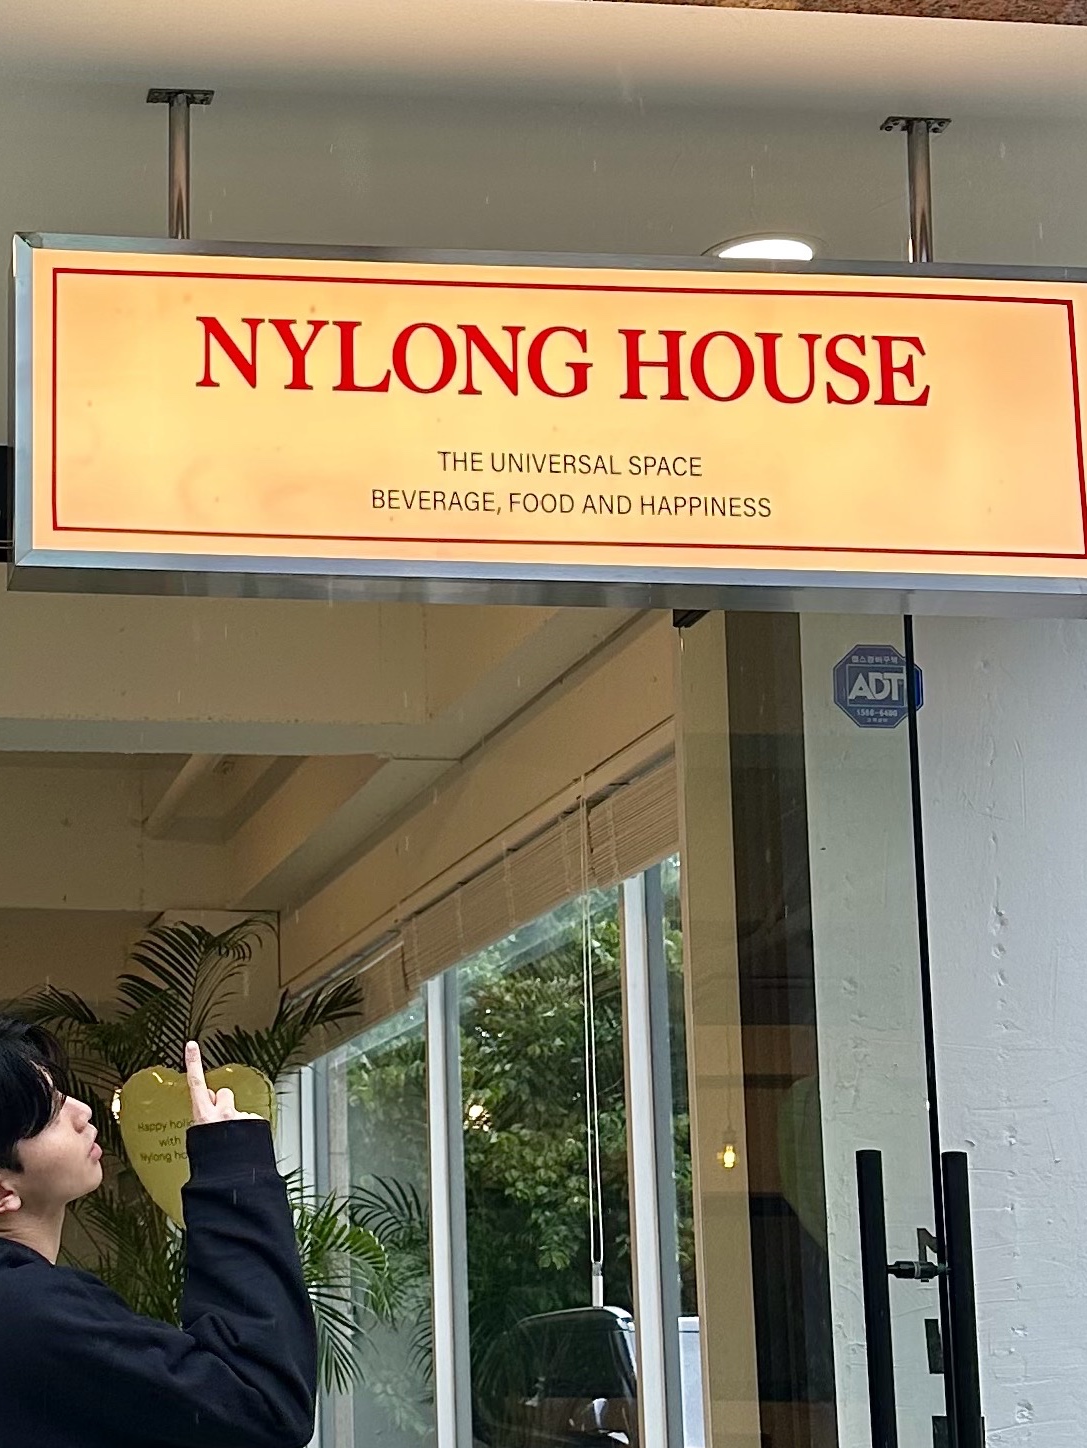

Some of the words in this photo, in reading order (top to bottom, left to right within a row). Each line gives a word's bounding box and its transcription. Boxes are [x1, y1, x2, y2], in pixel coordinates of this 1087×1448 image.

[195, 315, 594, 398] NYLONG
[618, 328, 931, 407] HOUSE
[437, 450, 484, 472] THE
[490, 451, 622, 476] UNIVERSAL
[628, 455, 703, 477] SPACE
[371, 488, 502, 516] BEVERAGE,
[508, 492, 575, 514] FOOD
[581, 493, 633, 516] AND
[639, 495, 772, 518] HAPPINESS
[847, 671, 905, 701] ADT
[158, 1136, 181, 1147] with
